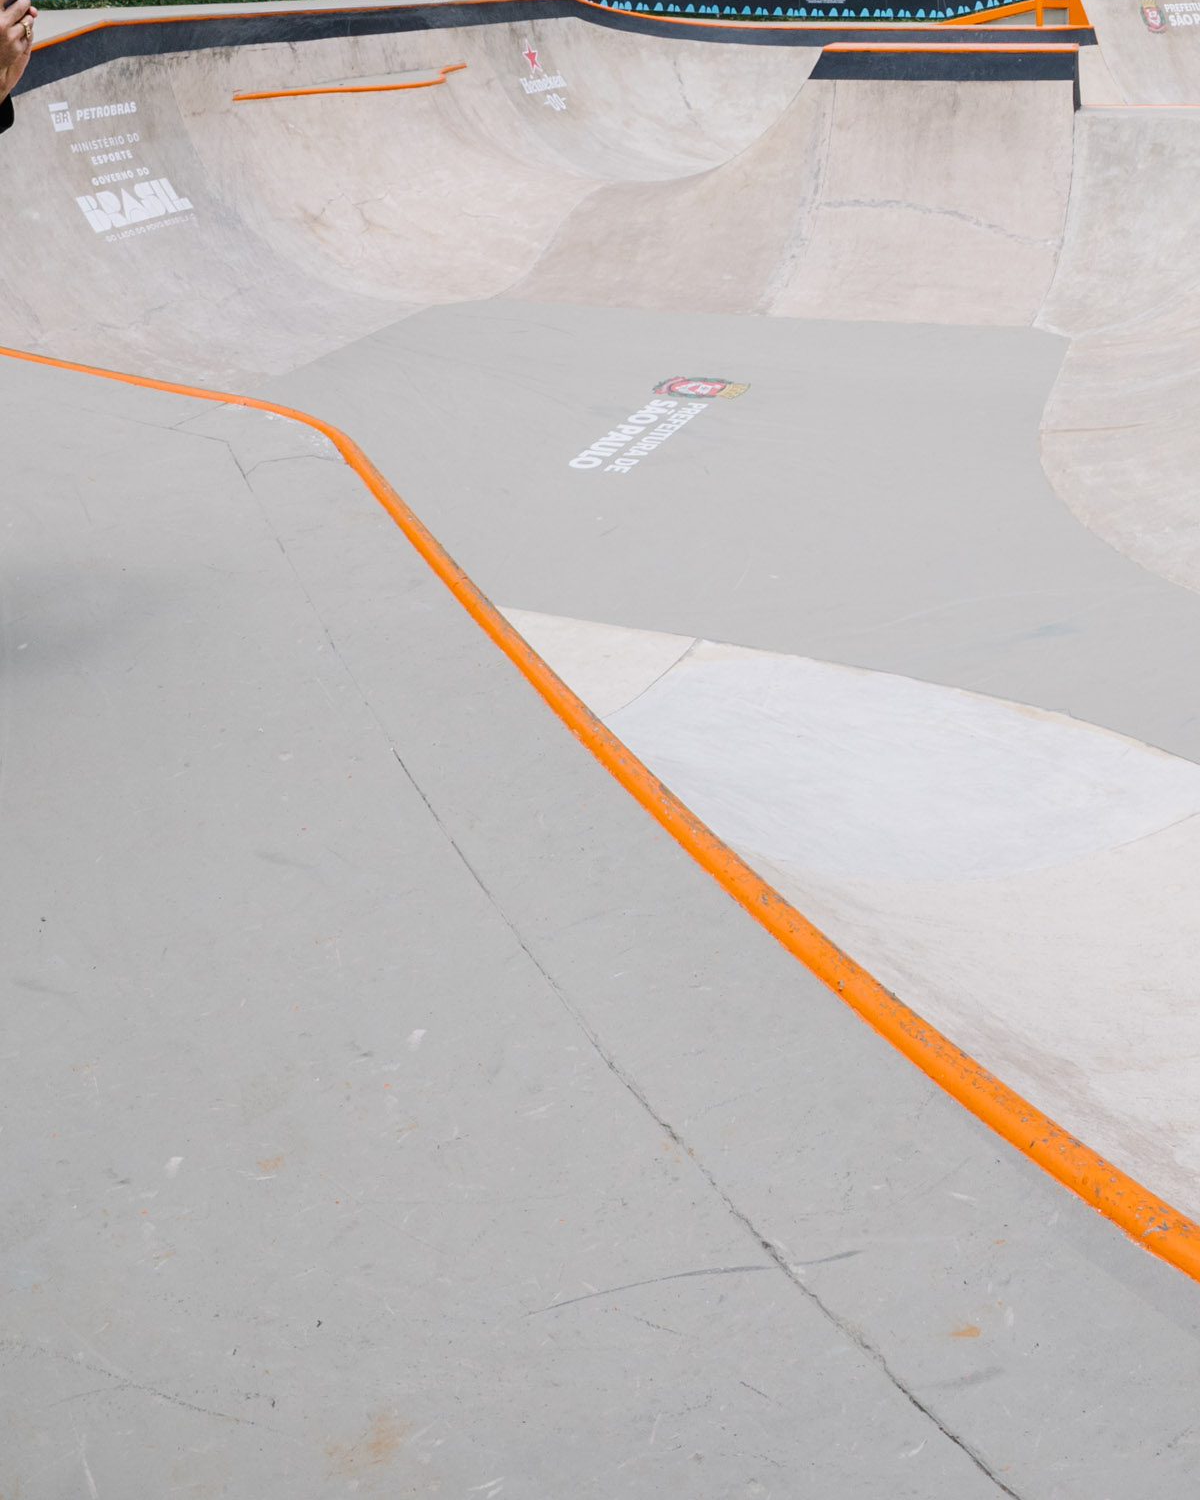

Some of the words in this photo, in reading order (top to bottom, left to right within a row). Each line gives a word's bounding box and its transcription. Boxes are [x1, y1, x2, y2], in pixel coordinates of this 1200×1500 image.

[1168, 12, 1193, 27] SÃO
[520, 73, 567, 94] Heineken
[76, 101, 137, 122] PETROBRAS
[70, 134, 125, 154] MINISTÉRIO
[127, 132, 140, 143] DO
[91, 150, 133, 166] ESPORTE
[91, 170, 134, 186] GOVERNO
[136, 167, 150, 177] DO
[76, 177, 194, 233] BRASIL
[627, 399, 678, 425] SÃO
[623, 402, 709, 458] PREFEITURA
[568, 423, 646, 469] PAULO
[603, 458, 640, 474] DE
